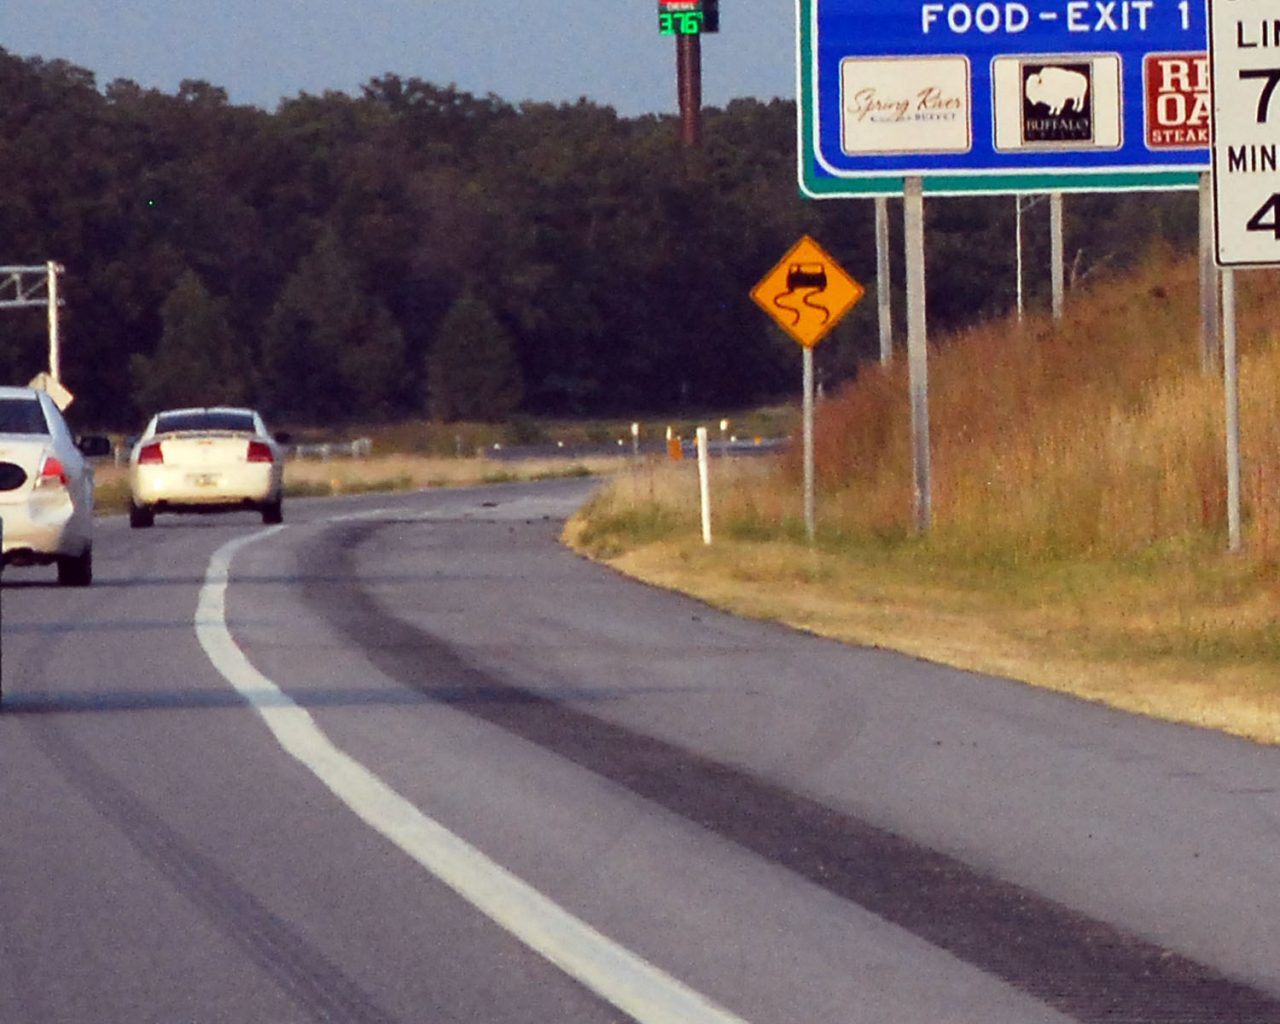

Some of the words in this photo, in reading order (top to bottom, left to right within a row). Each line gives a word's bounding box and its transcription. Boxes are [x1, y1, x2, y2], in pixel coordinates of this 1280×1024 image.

[1178, 0, 1190, 31] 1
[847, 87, 910, 122] Spring
[916, 87, 961, 111] River
[1026, 118, 1089, 132] BUFFALO
